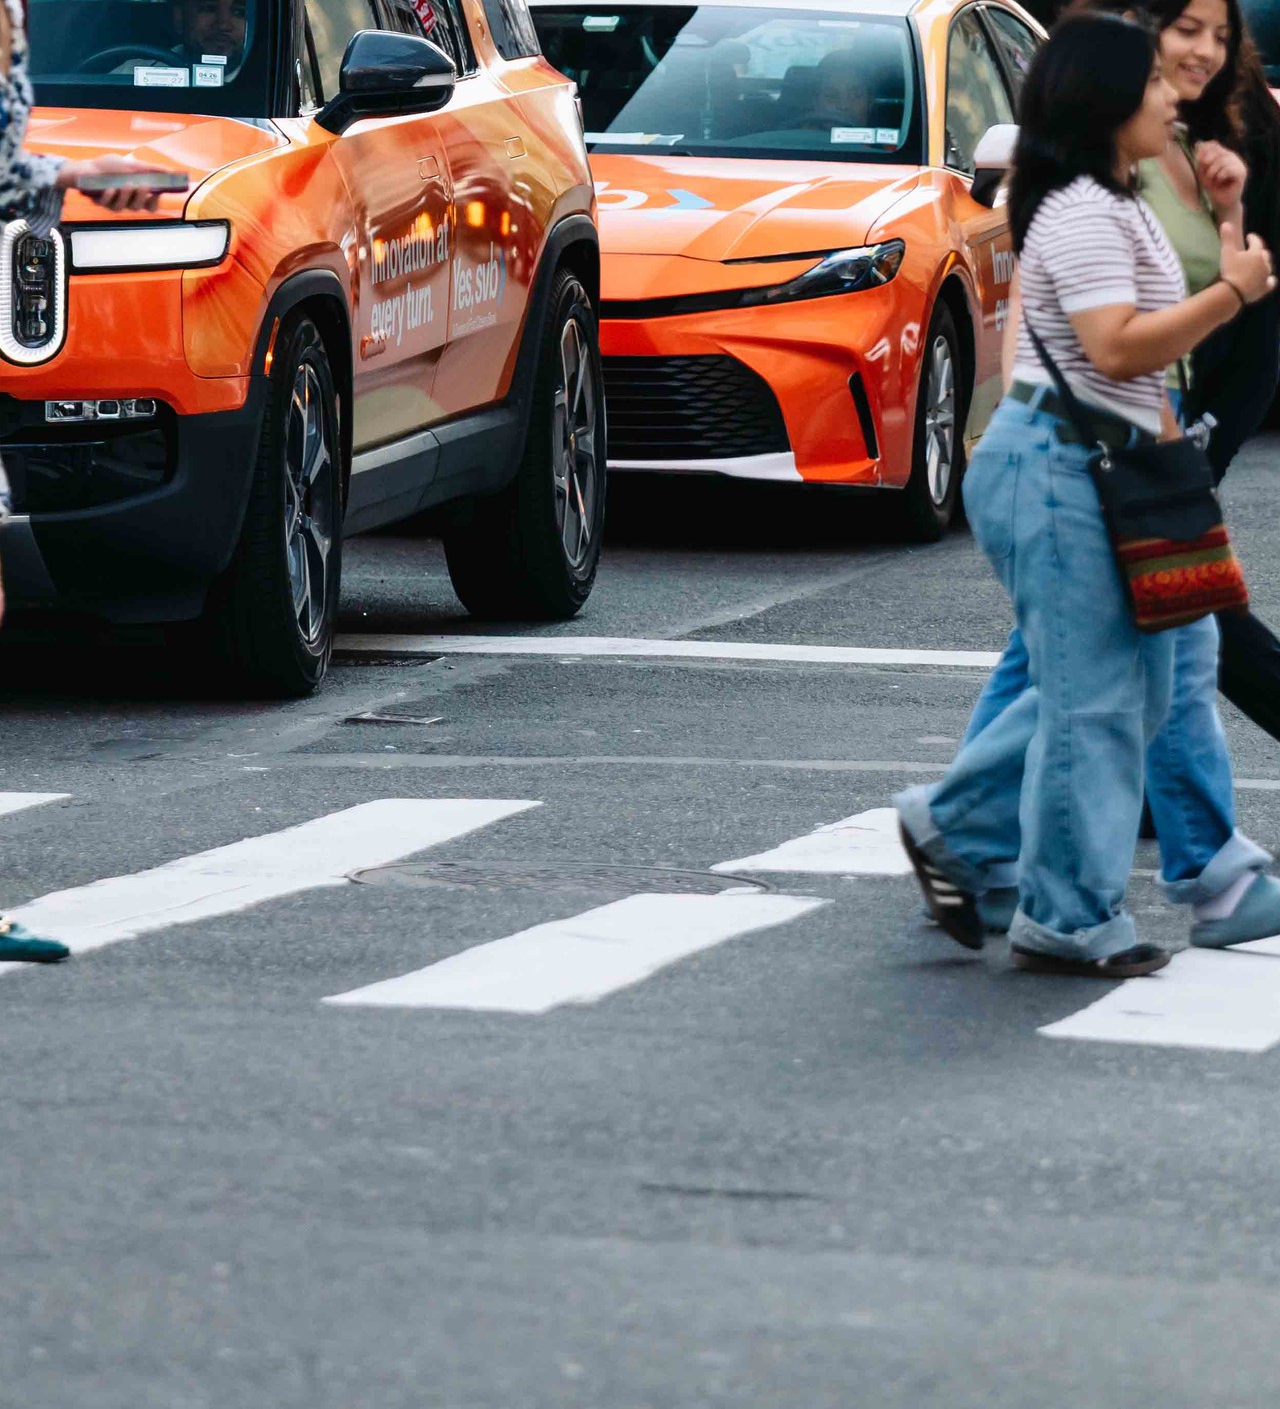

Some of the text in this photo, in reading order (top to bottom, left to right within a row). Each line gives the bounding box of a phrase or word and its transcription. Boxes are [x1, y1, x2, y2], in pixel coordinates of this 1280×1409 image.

[370, 213, 449, 285] Innovation at
[453, 241, 498, 314] Yes, svb
[371, 294, 405, 347] every
[407, 282, 434, 331] turn.
